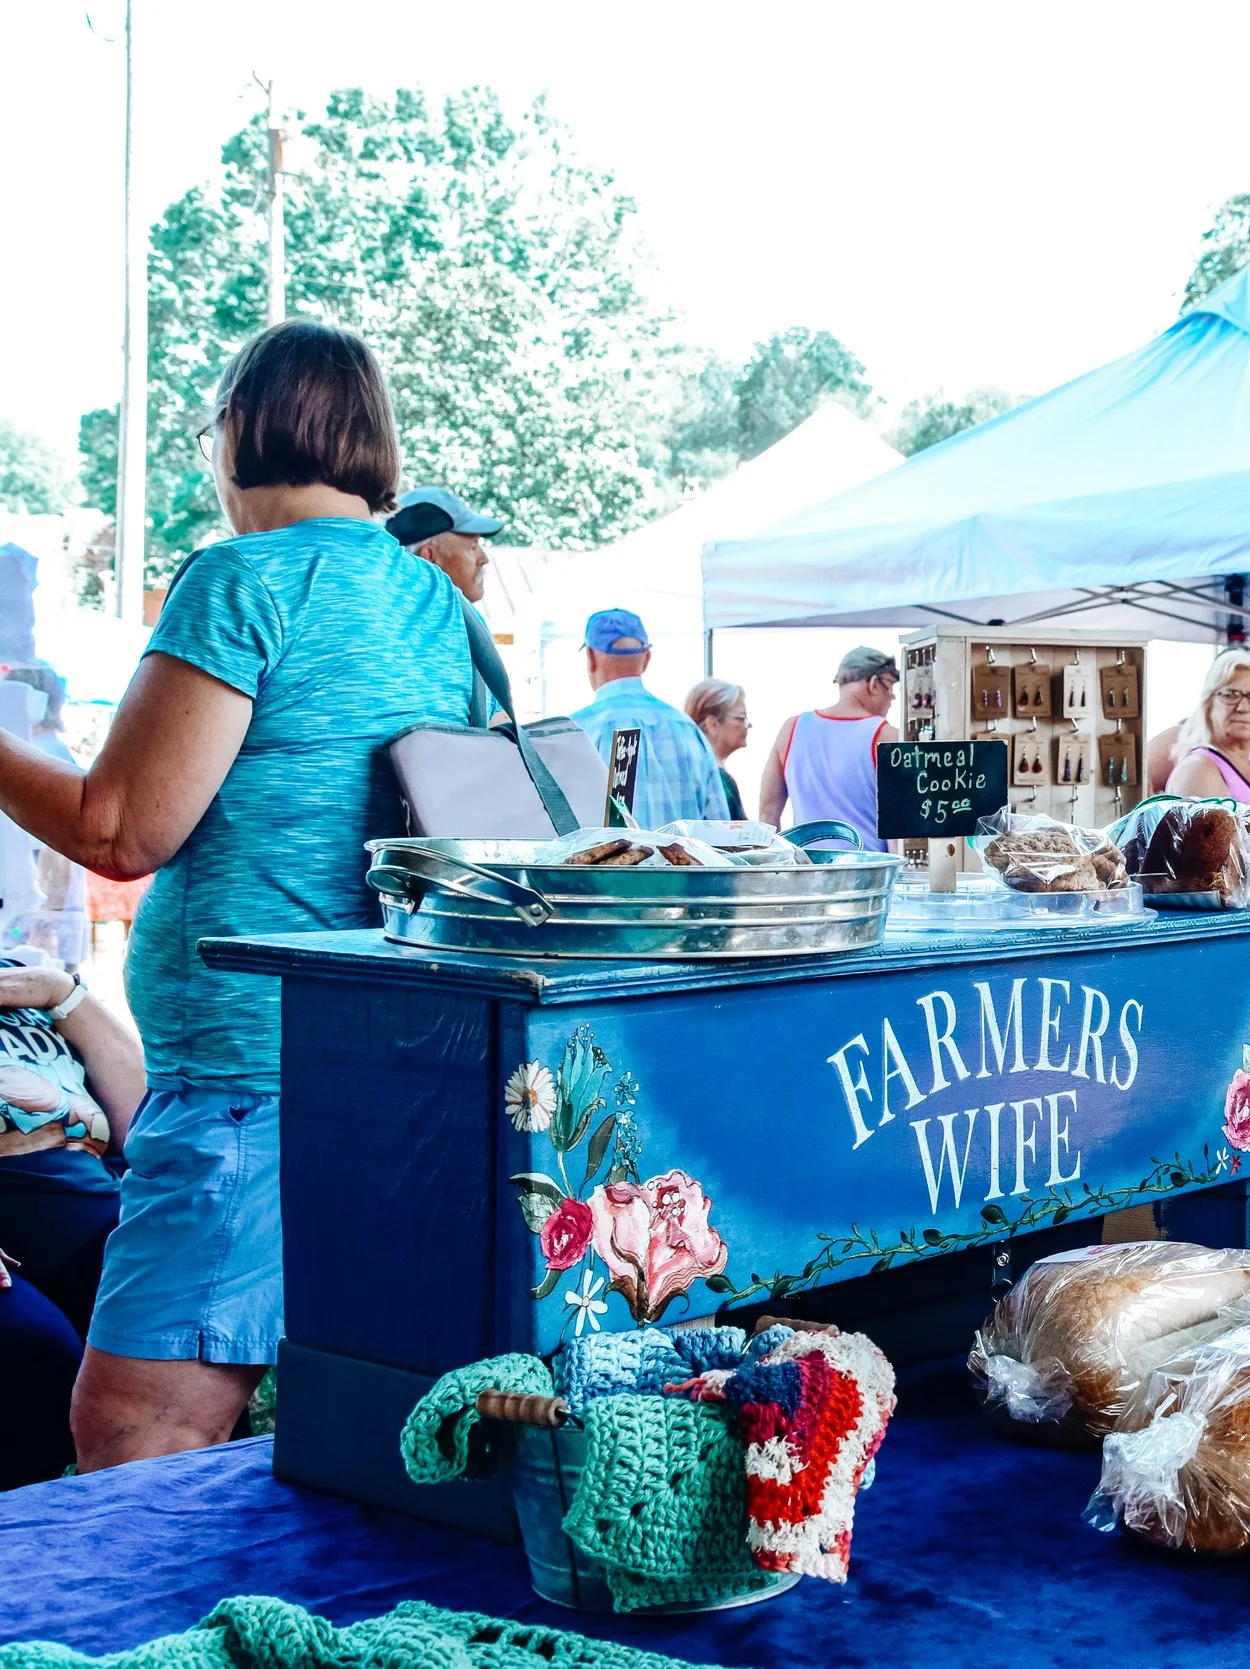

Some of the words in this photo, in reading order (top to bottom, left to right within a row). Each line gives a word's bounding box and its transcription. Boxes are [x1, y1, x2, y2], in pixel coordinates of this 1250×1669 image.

[890, 743, 974, 768] Oatmeal
[826, 977, 1143, 1150] FARMERS
[910, 1090, 1081, 1214] WIFE
